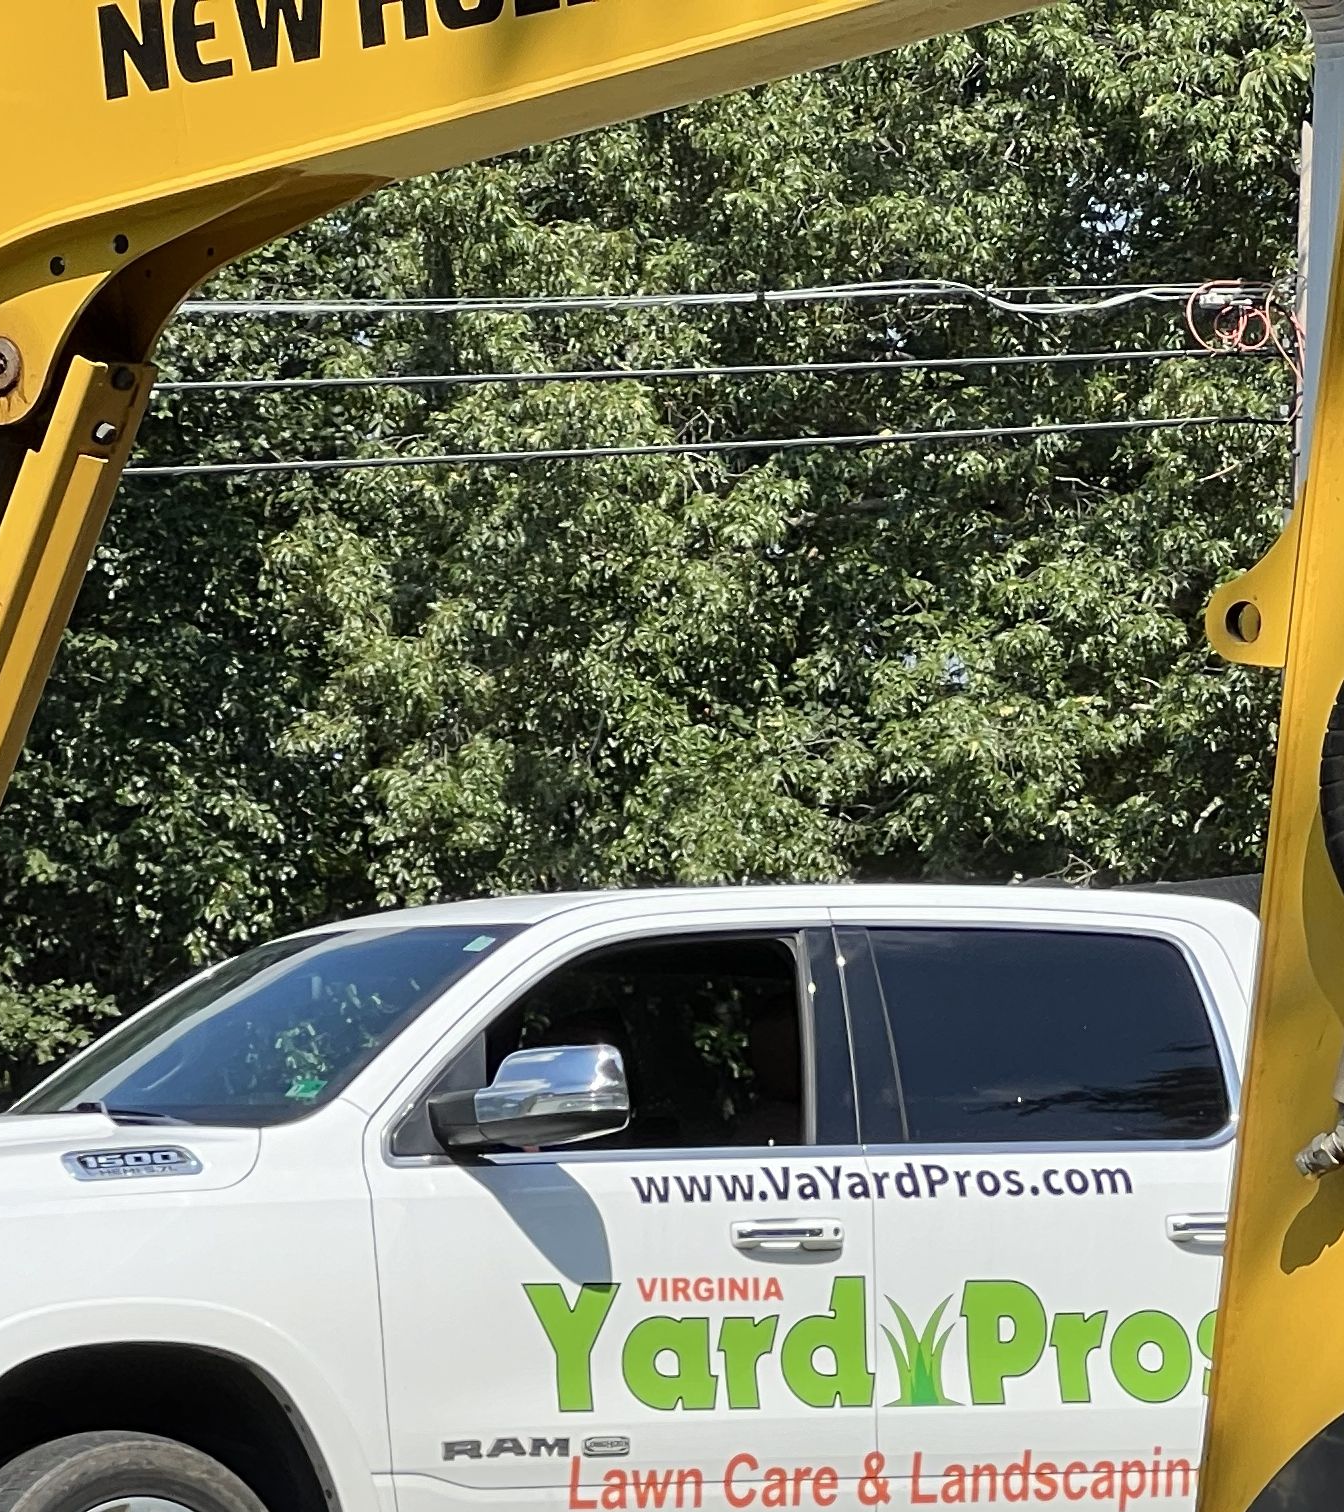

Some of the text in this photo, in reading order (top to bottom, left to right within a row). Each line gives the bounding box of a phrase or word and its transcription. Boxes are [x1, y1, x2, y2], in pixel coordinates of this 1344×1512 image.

[97, 0, 323, 101] NEW
[80, 1151, 178, 1168] 1500
[630, 1162, 1134, 1204] www.VaYardPros.com
[637, 1276, 784, 1303] VIRGINIA
[520, 1275, 1214, 1414] Yard Pro
[441, 1436, 570, 1462] RAM
[567, 1446, 1199, 1512] Lawn Care & Landscapin
